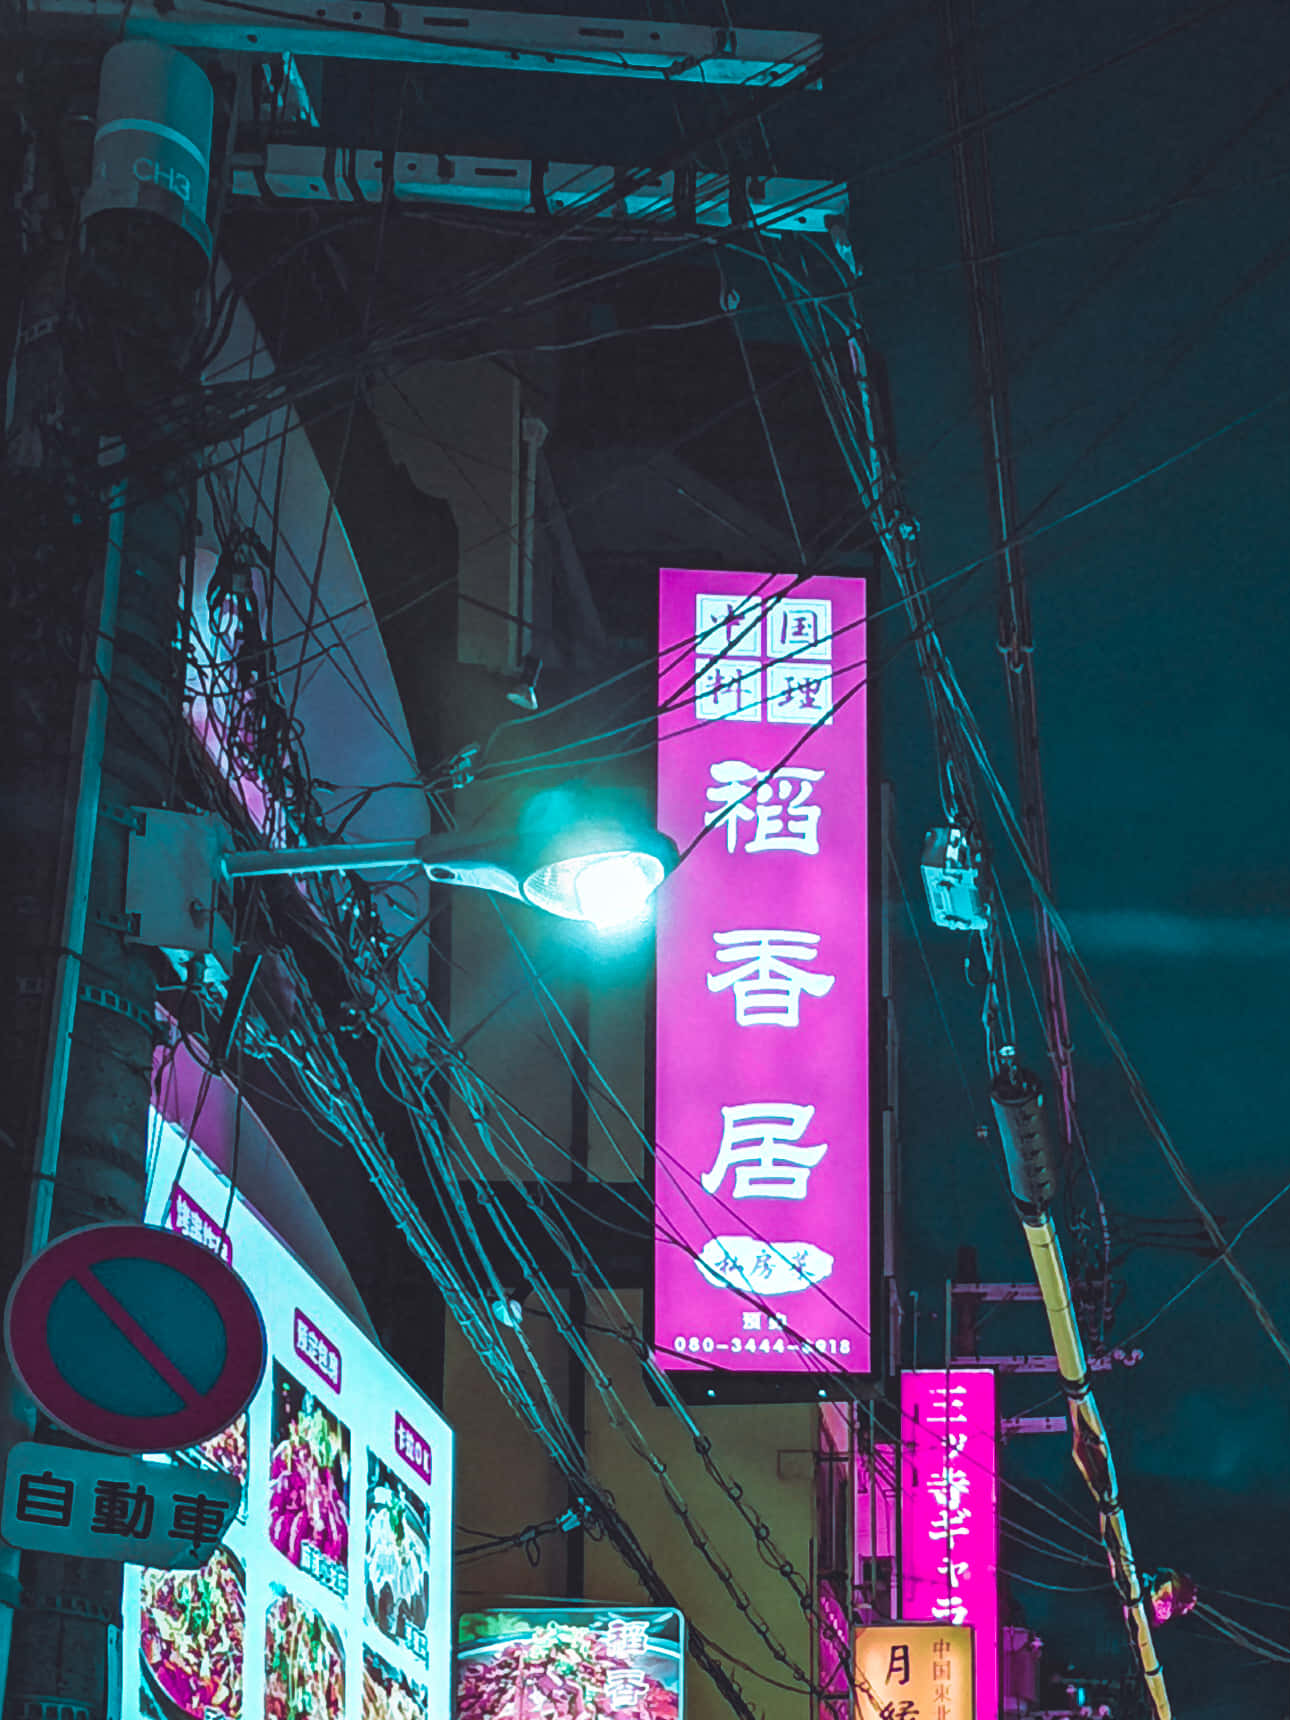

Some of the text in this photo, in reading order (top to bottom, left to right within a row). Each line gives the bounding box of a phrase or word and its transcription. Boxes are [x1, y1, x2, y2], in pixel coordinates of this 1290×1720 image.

[703, 668, 824, 713] 料理
[15, 1470, 230, 1544] 自動車
